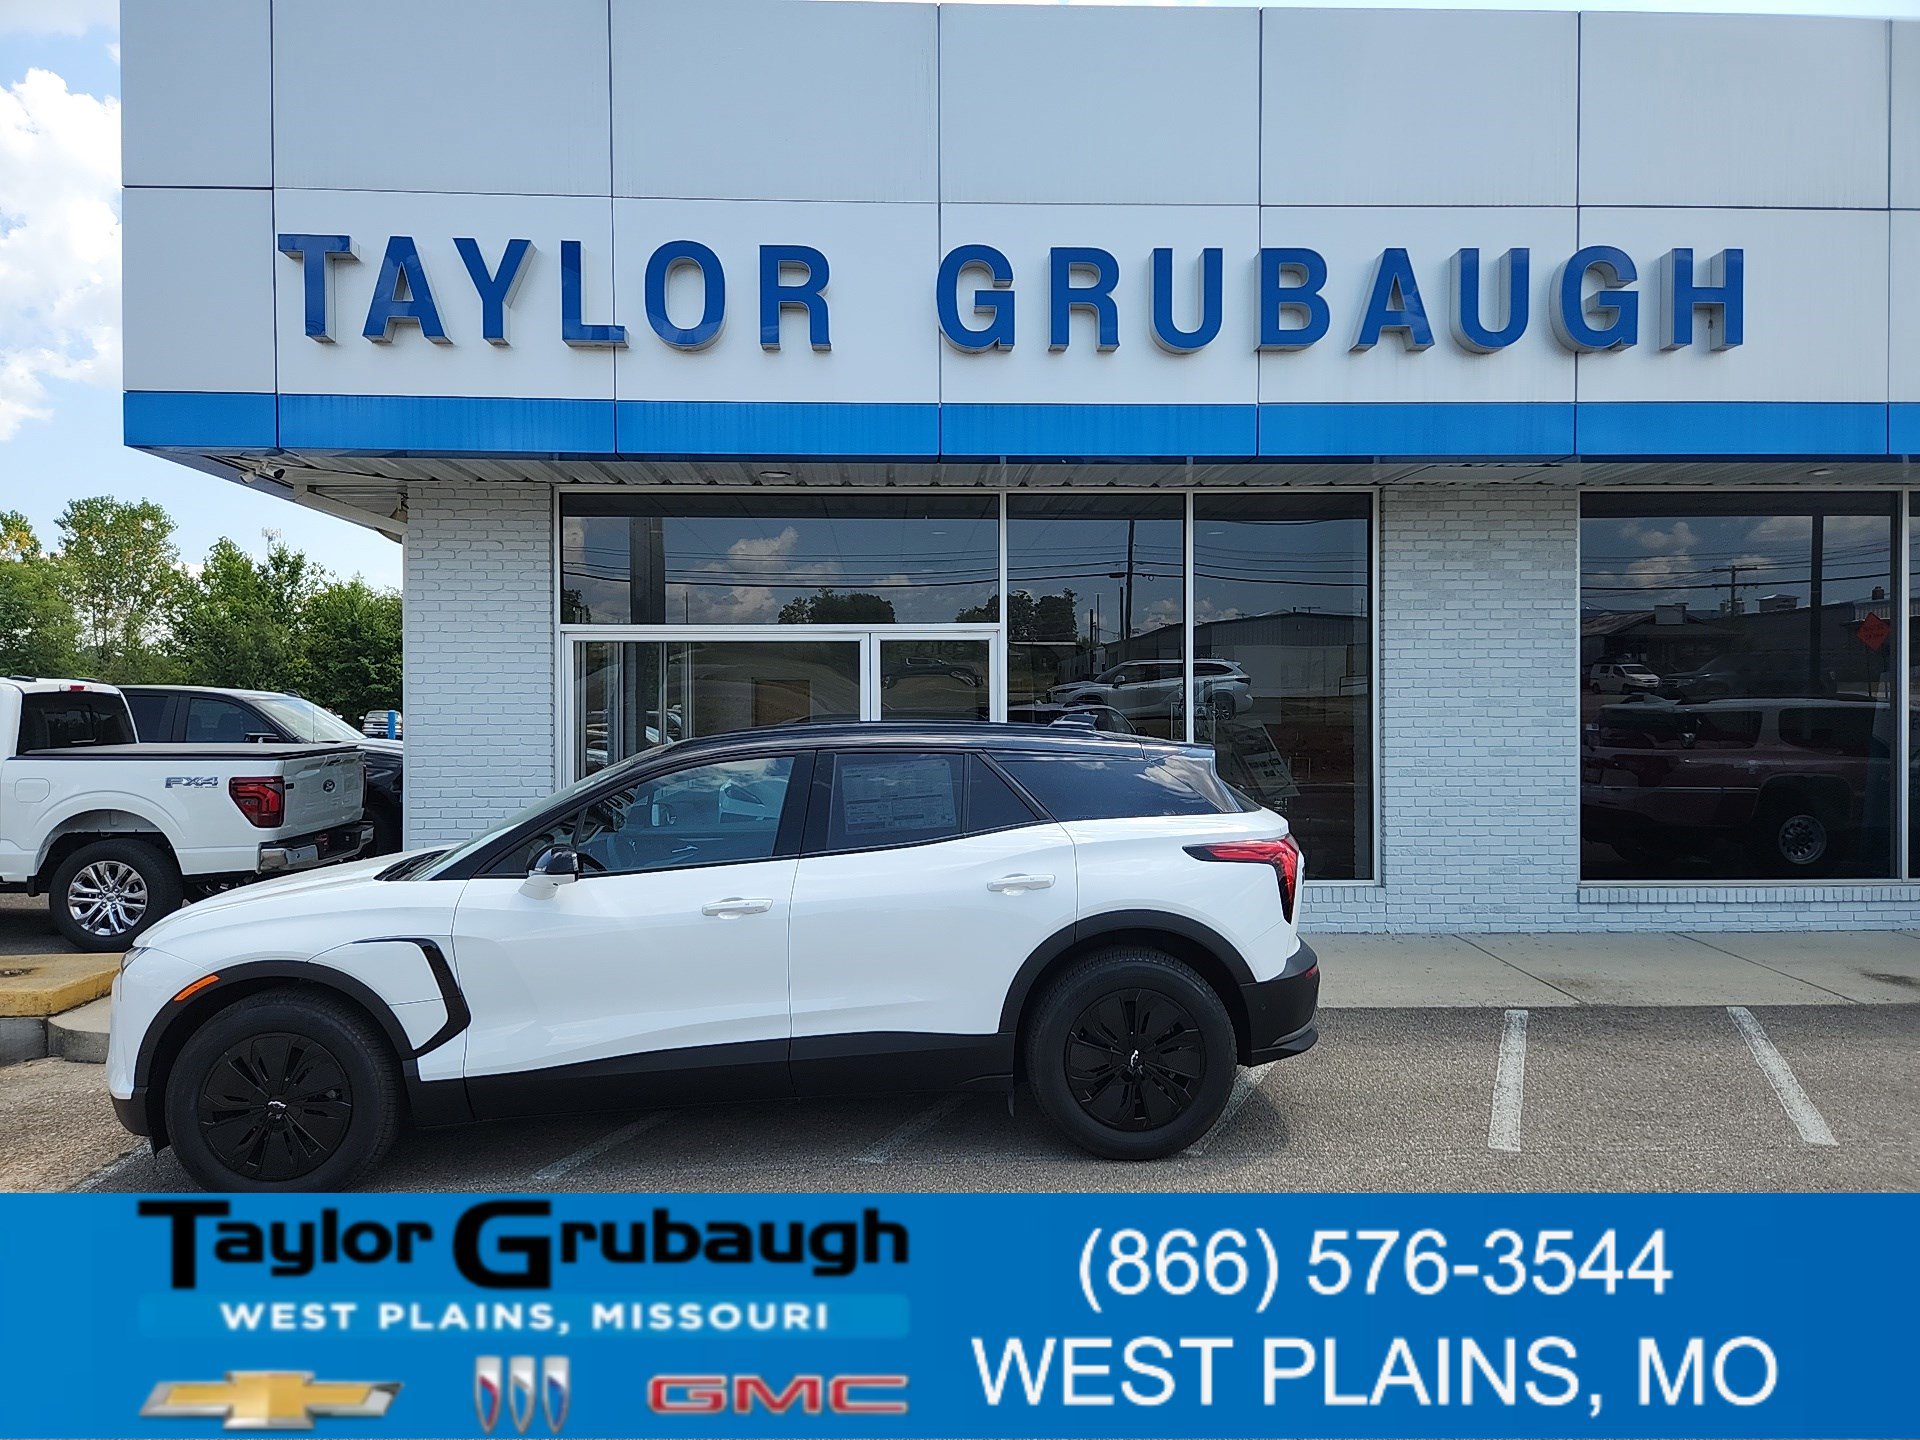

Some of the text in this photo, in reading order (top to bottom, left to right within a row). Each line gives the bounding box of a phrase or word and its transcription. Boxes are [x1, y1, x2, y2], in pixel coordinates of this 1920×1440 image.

[278, 233, 1744, 353] TAYLOR GRUBAUGH
[165, 776, 218, 788] FX4
